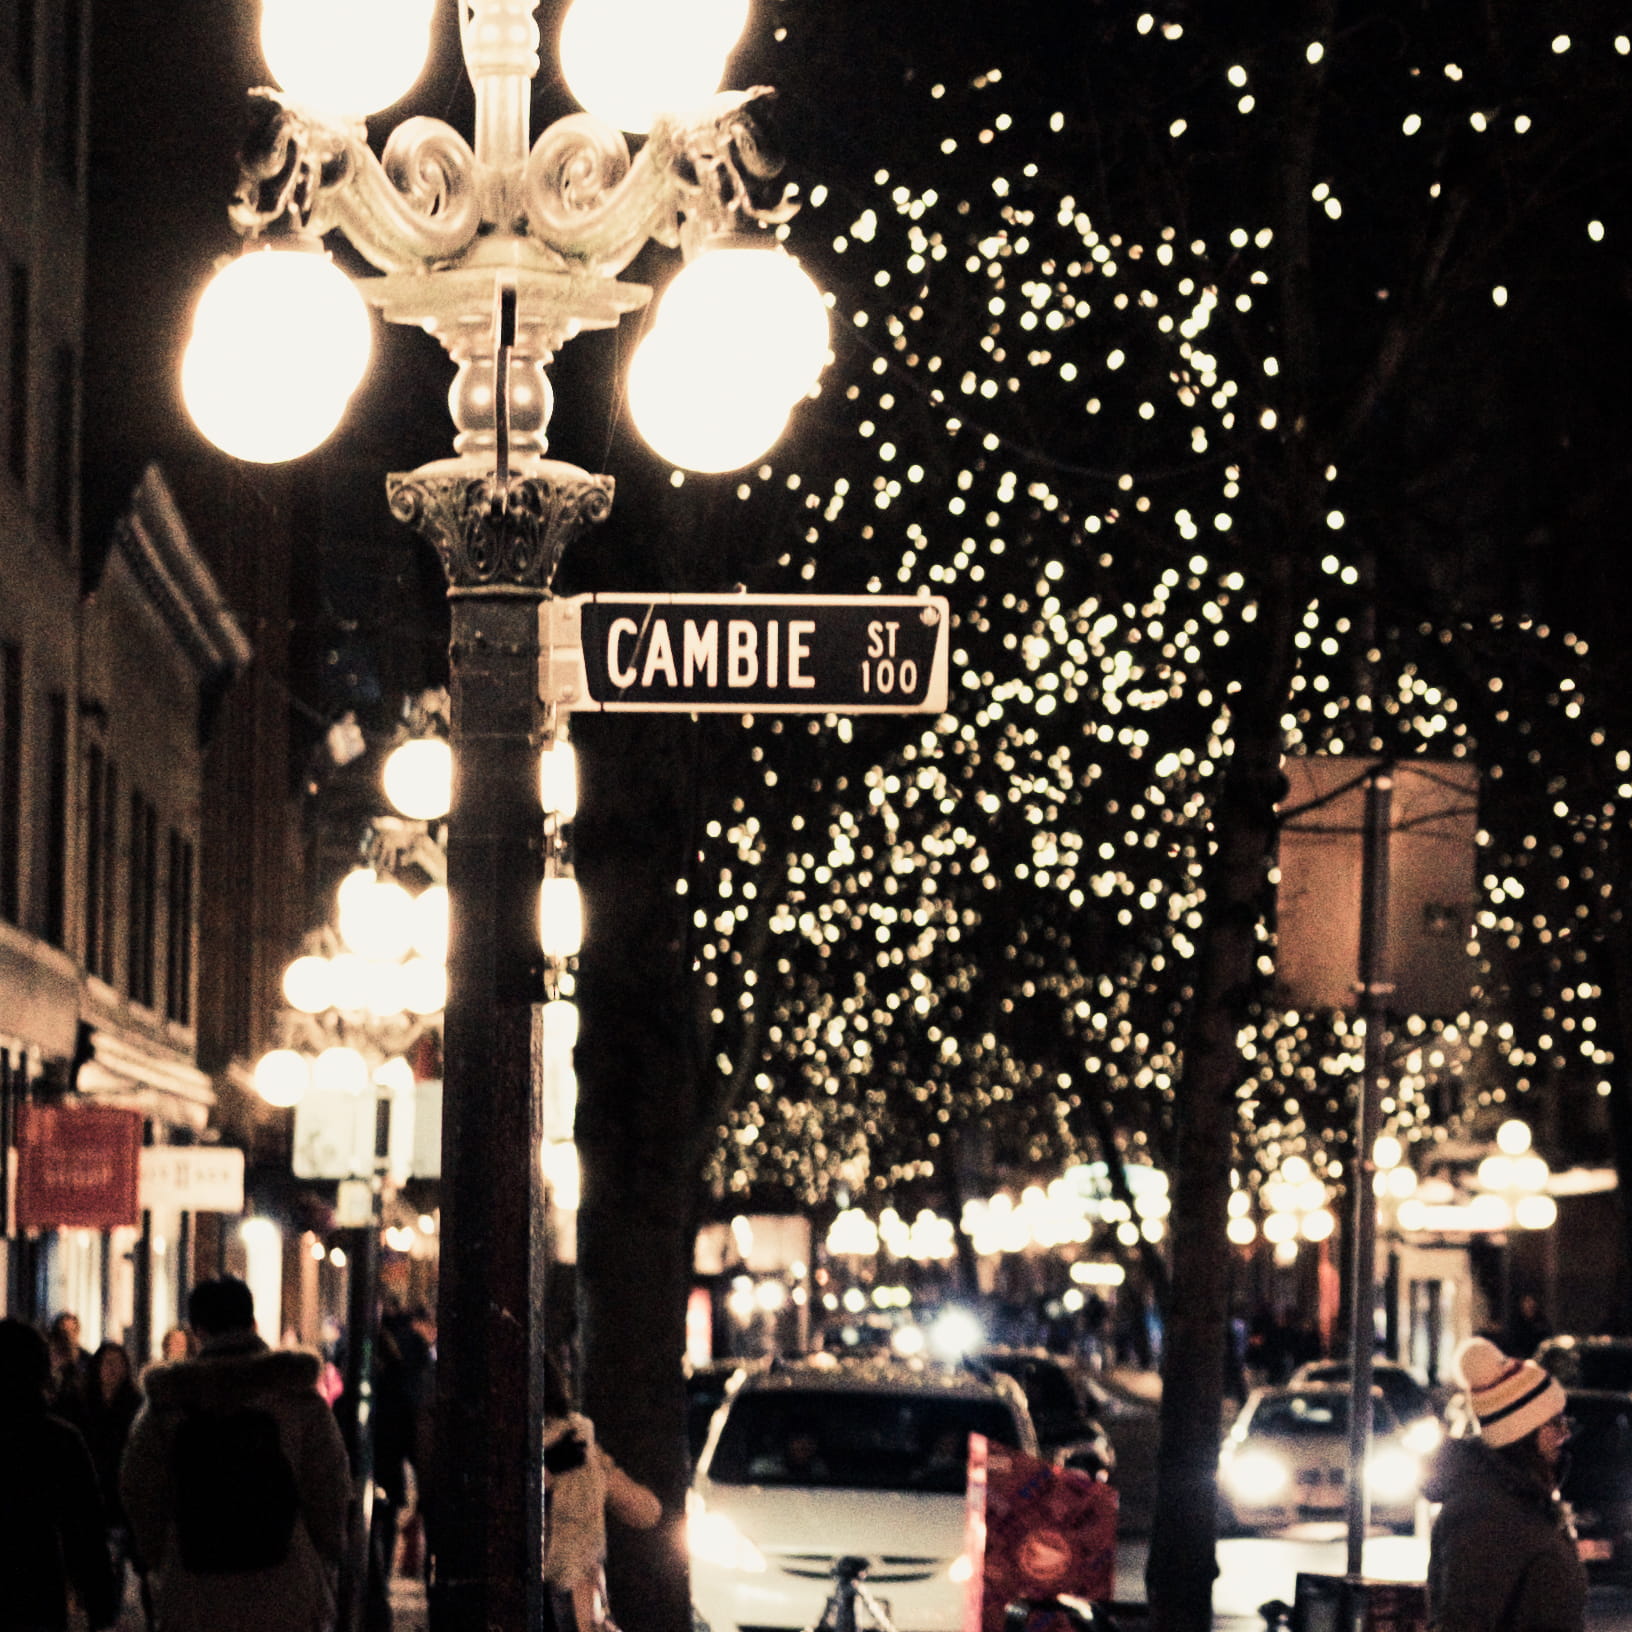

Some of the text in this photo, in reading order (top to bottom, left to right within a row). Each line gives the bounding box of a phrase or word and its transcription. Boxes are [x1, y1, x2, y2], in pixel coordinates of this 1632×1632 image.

[607, 617, 900, 689] CAMBIE ST
[860, 659, 918, 694] 100
